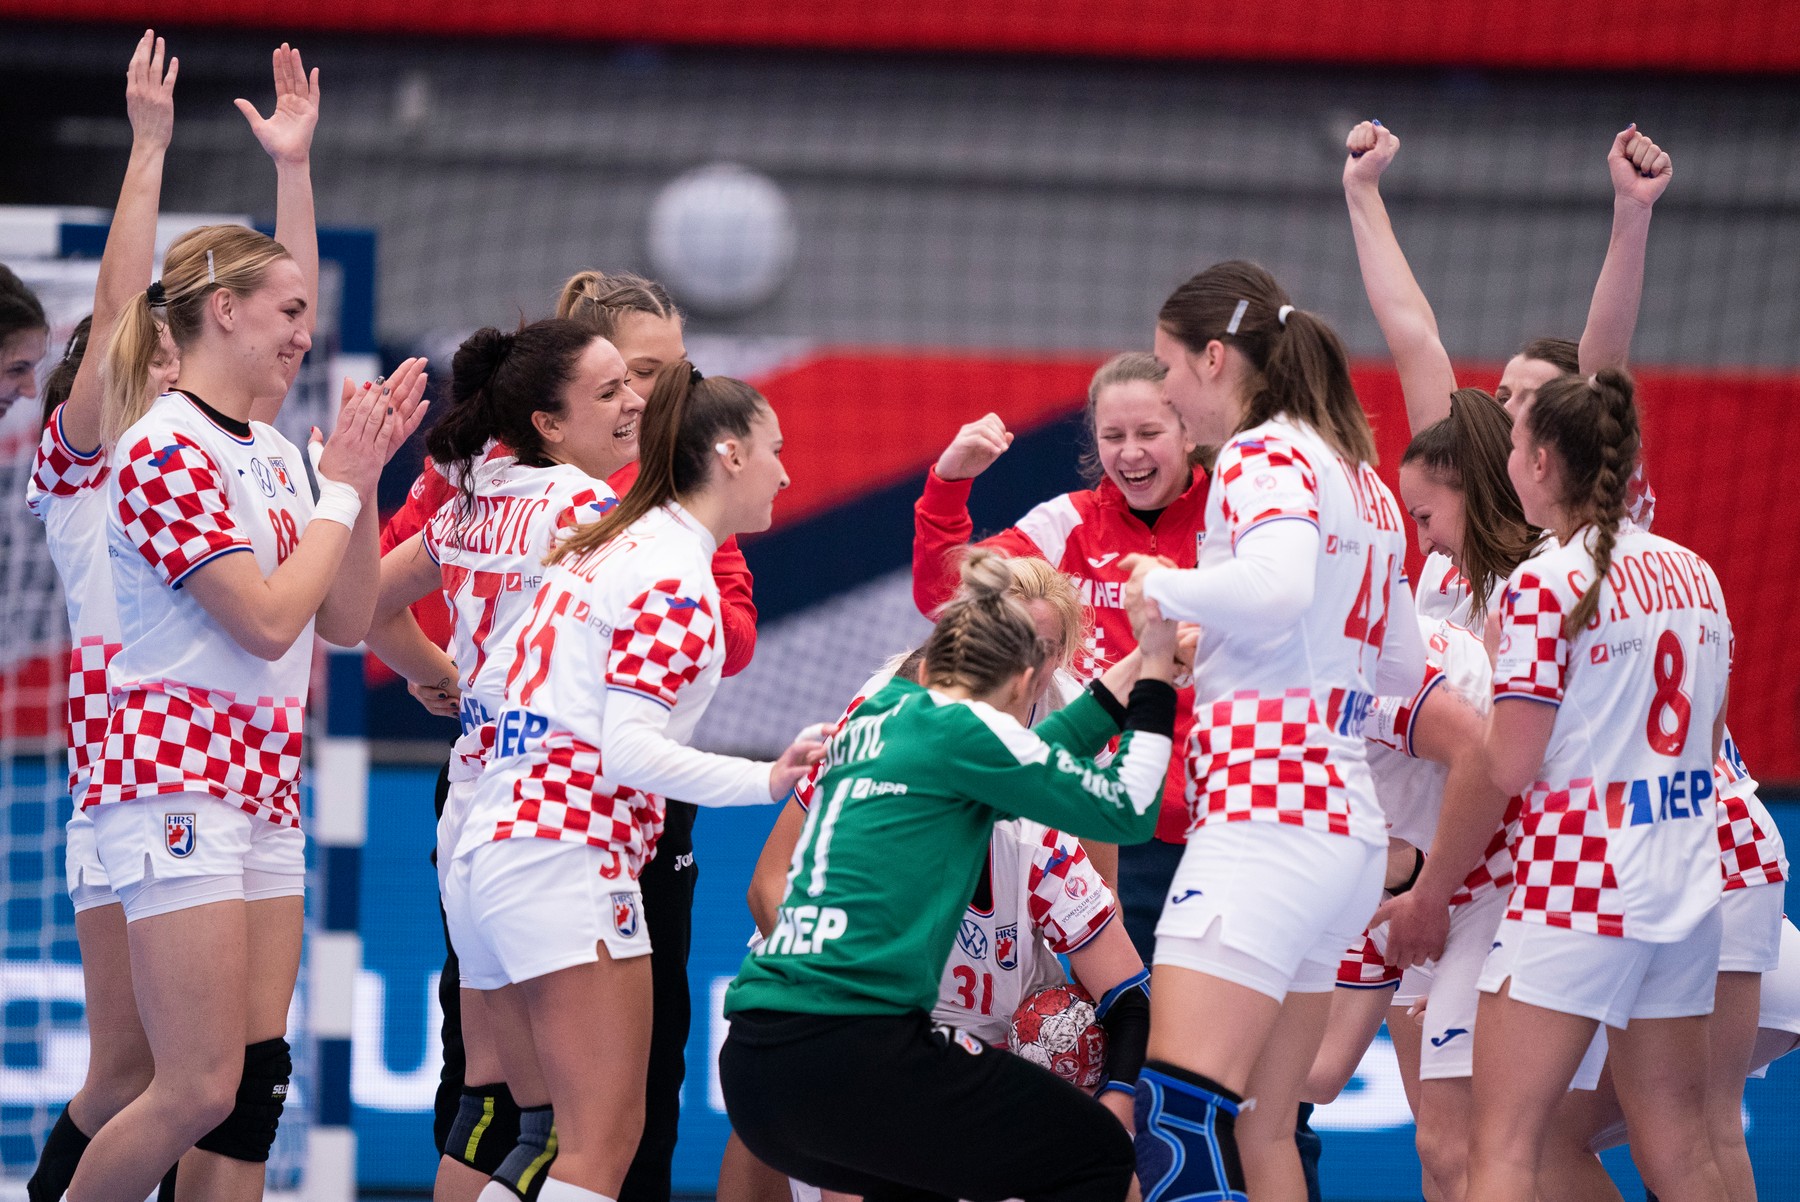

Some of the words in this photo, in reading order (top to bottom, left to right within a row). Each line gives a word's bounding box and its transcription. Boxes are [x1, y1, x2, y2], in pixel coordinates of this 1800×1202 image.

[523, 575, 543, 589] HP
[1646, 629, 1693, 759] 8
[168, 816, 193, 825] HRS
[767, 905, 848, 955] HEP
[996, 926, 1018, 940] HRS
[950, 964, 995, 1017] 31
